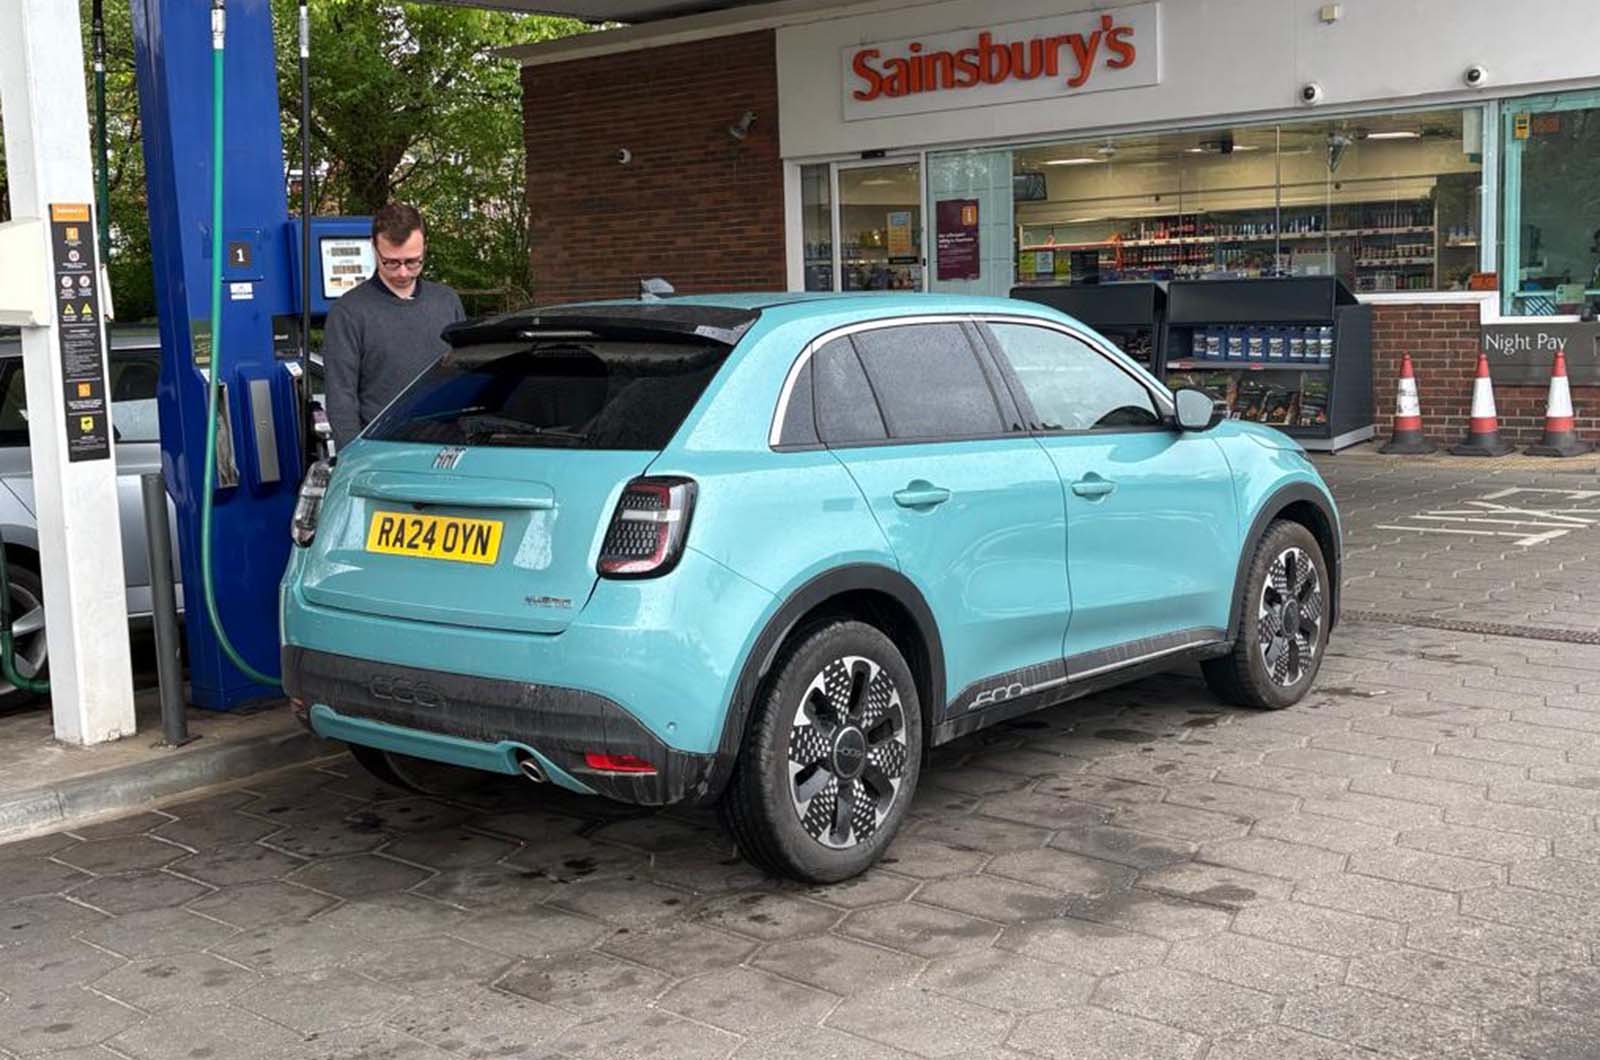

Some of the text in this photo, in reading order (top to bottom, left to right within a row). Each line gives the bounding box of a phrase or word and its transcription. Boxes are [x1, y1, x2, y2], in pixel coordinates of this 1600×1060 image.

[852, 15, 1136, 101] Sainsbury's
[236, 248, 245, 262] 1
[1485, 332, 1568, 356] Night Pay
[377, 517, 492, 556] RA24 OYN
